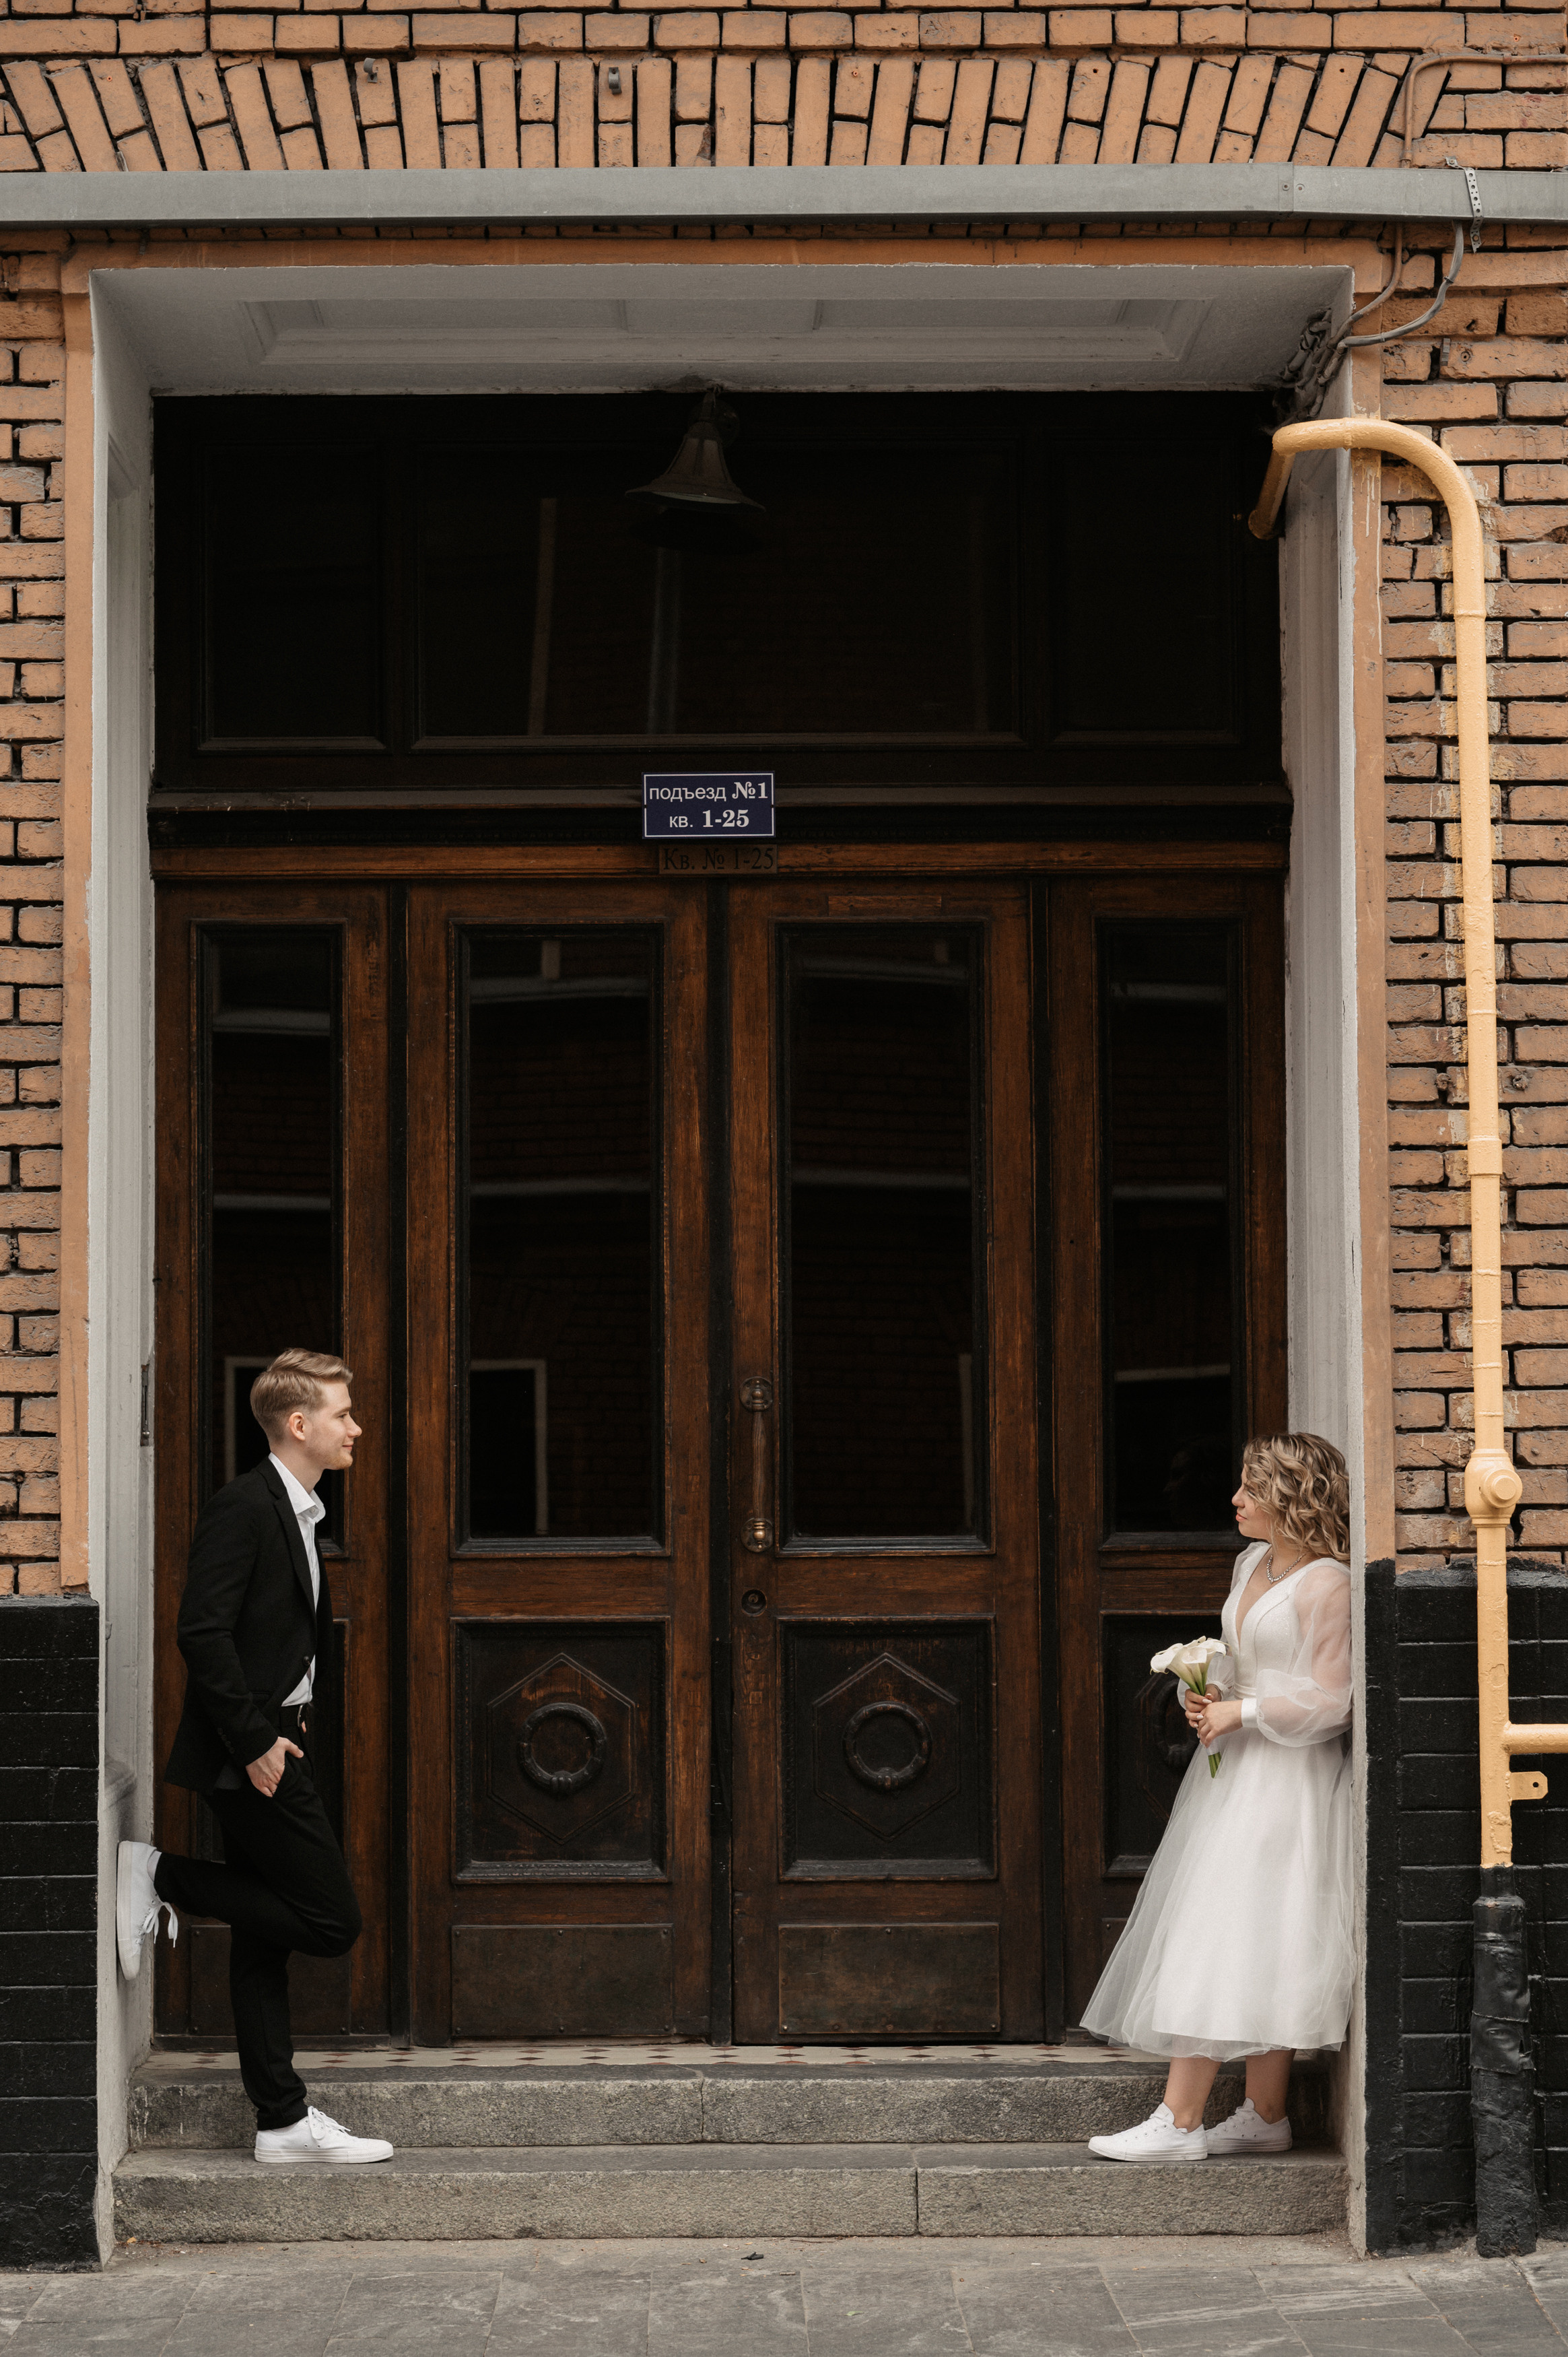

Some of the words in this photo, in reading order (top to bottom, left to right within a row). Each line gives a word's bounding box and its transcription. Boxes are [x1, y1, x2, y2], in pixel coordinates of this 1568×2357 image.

[649, 787, 726, 802] подъезд
[732, 781, 768, 799] №1
[669, 816, 693, 828] кв.
[702, 809, 749, 828] 1-25
[663, 848, 695, 869] Кв.
[733, 847, 774, 869] 1-25
